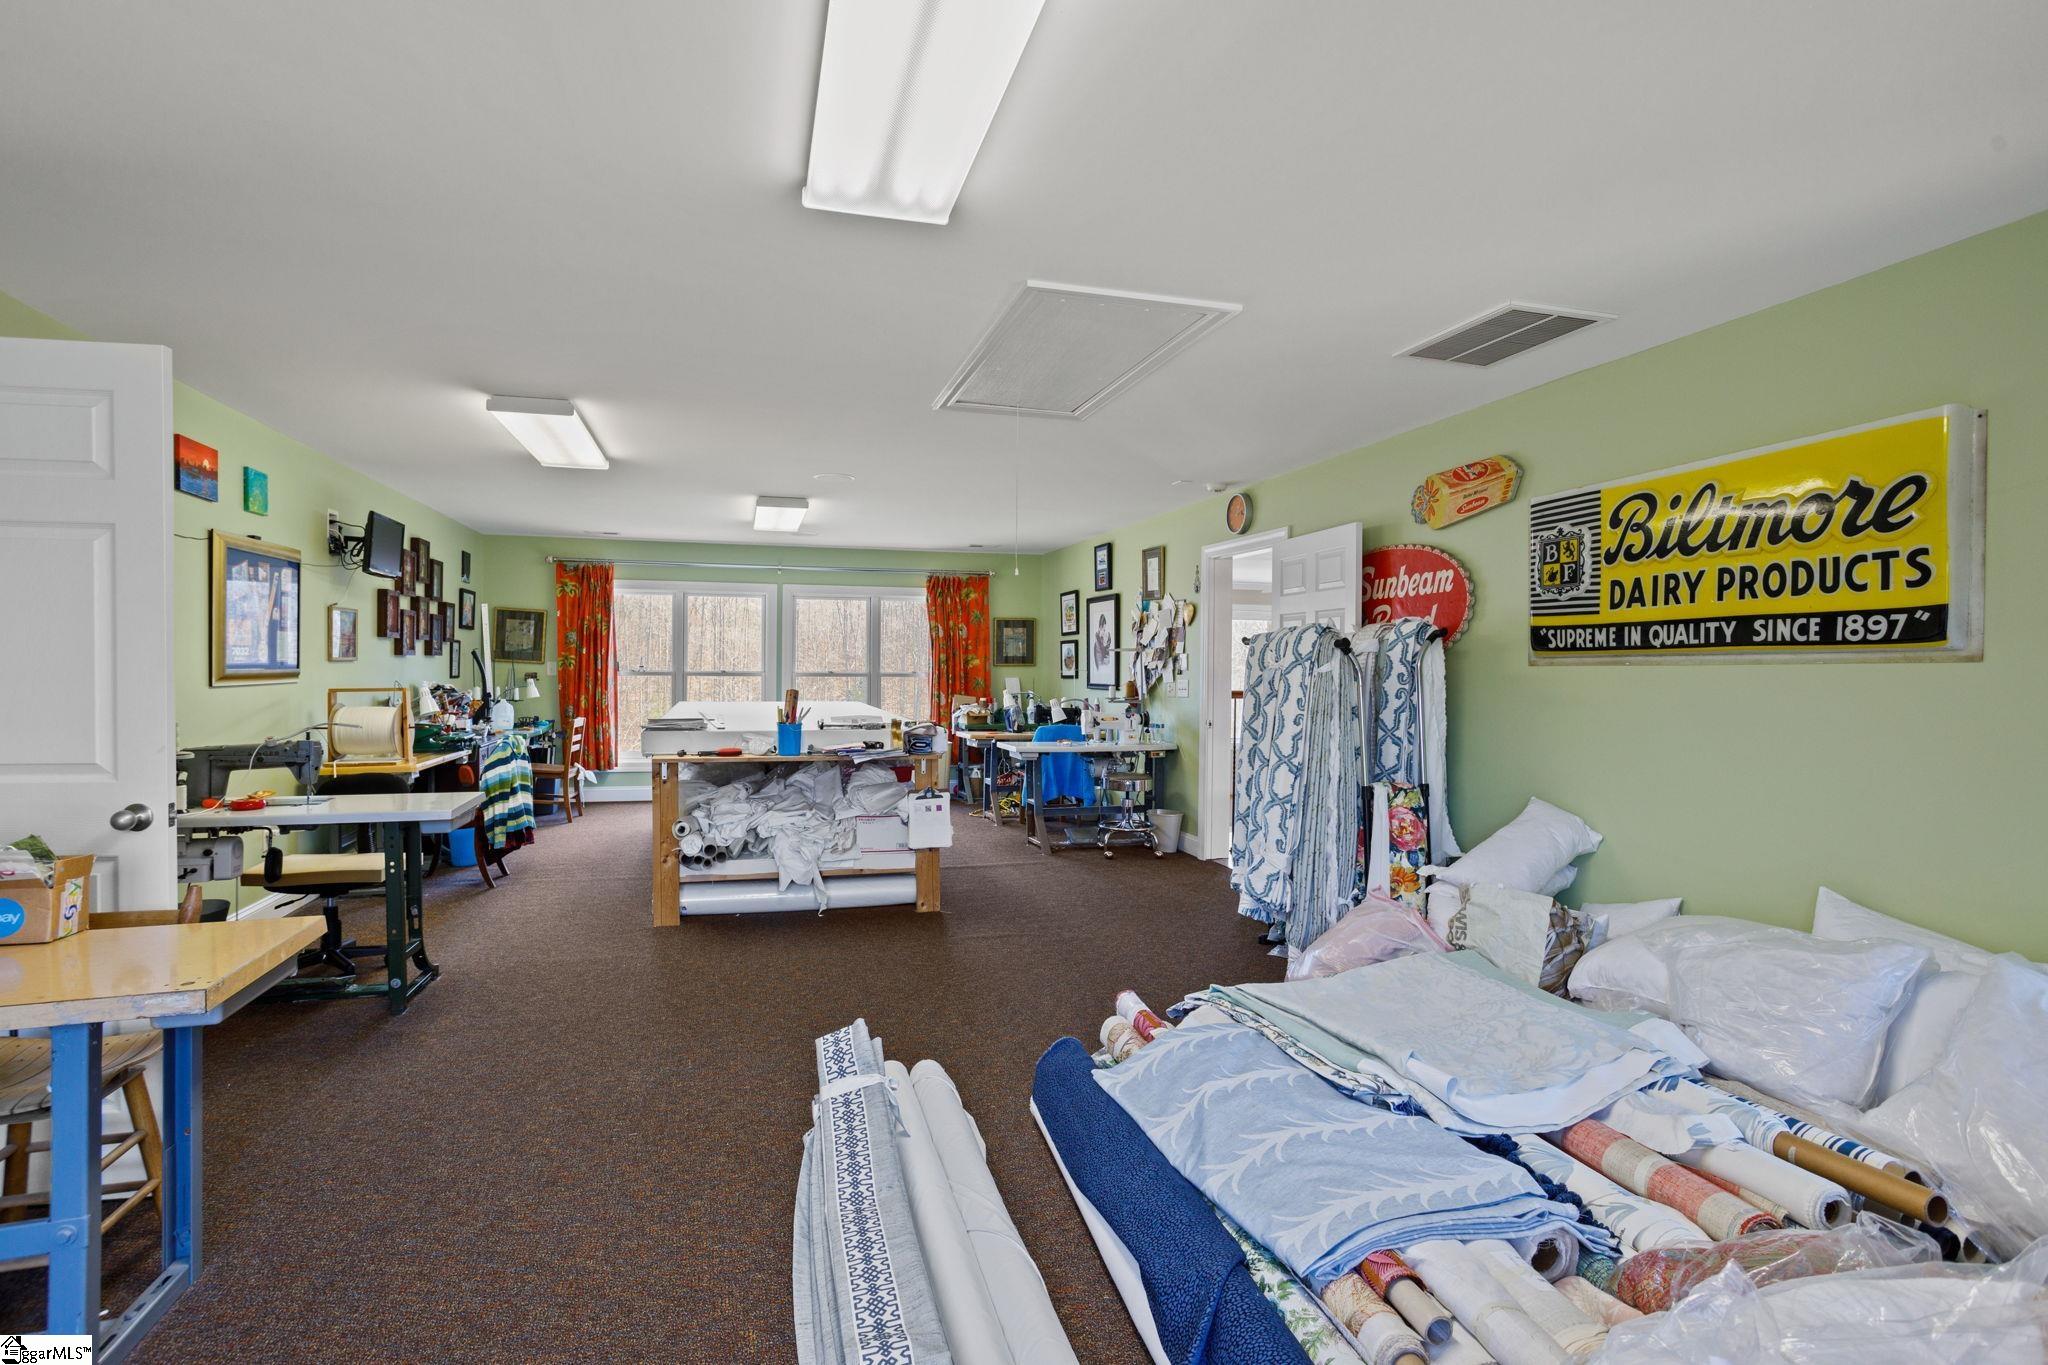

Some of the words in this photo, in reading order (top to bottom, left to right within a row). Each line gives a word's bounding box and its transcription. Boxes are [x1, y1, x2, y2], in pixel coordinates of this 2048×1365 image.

[1603, 474, 1929, 566] Biltmore
[1544, 544, 1558, 563] B
[1363, 564, 1455, 603] Sunbeam
[1562, 563, 1576, 582] F
[1609, 569, 1706, 611] DAIRY
[1716, 546, 1933, 602] PRODUCTS
[1624, 625, 1642, 647] IN
[1648, 620, 1737, 648] QUALITY
[1752, 617, 1821, 642] SINCE
